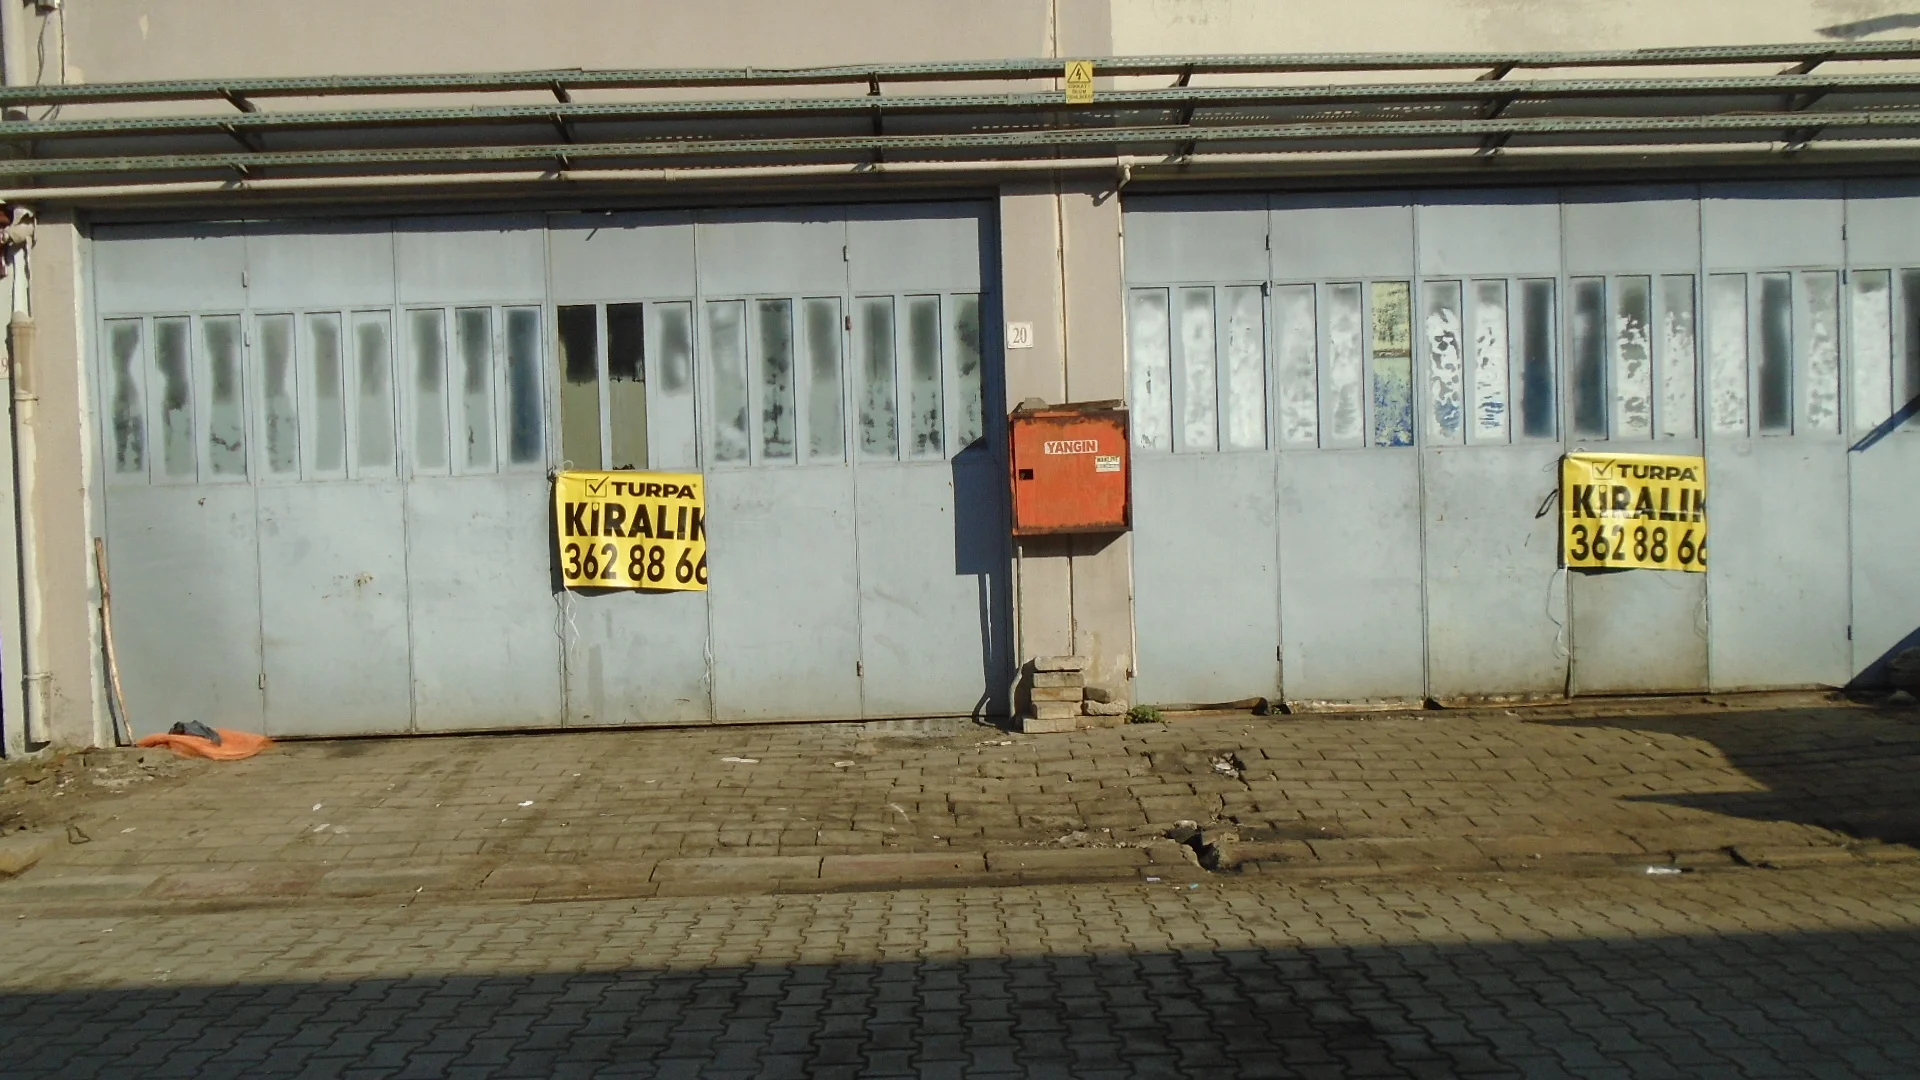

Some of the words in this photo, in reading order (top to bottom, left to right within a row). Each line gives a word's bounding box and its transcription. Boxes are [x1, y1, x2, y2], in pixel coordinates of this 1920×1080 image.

[1012, 327, 1027, 344] 20
[1046, 440, 1096, 454] YANGIN
[1617, 464, 1698, 482] TURPA
[611, 481, 696, 499] TURPA
[1570, 524, 1625, 561] 362
[1633, 525, 1668, 563] 88
[564, 543, 618, 580] 362
[628, 544, 665, 582] 88
[675, 548, 708, 585] 66
